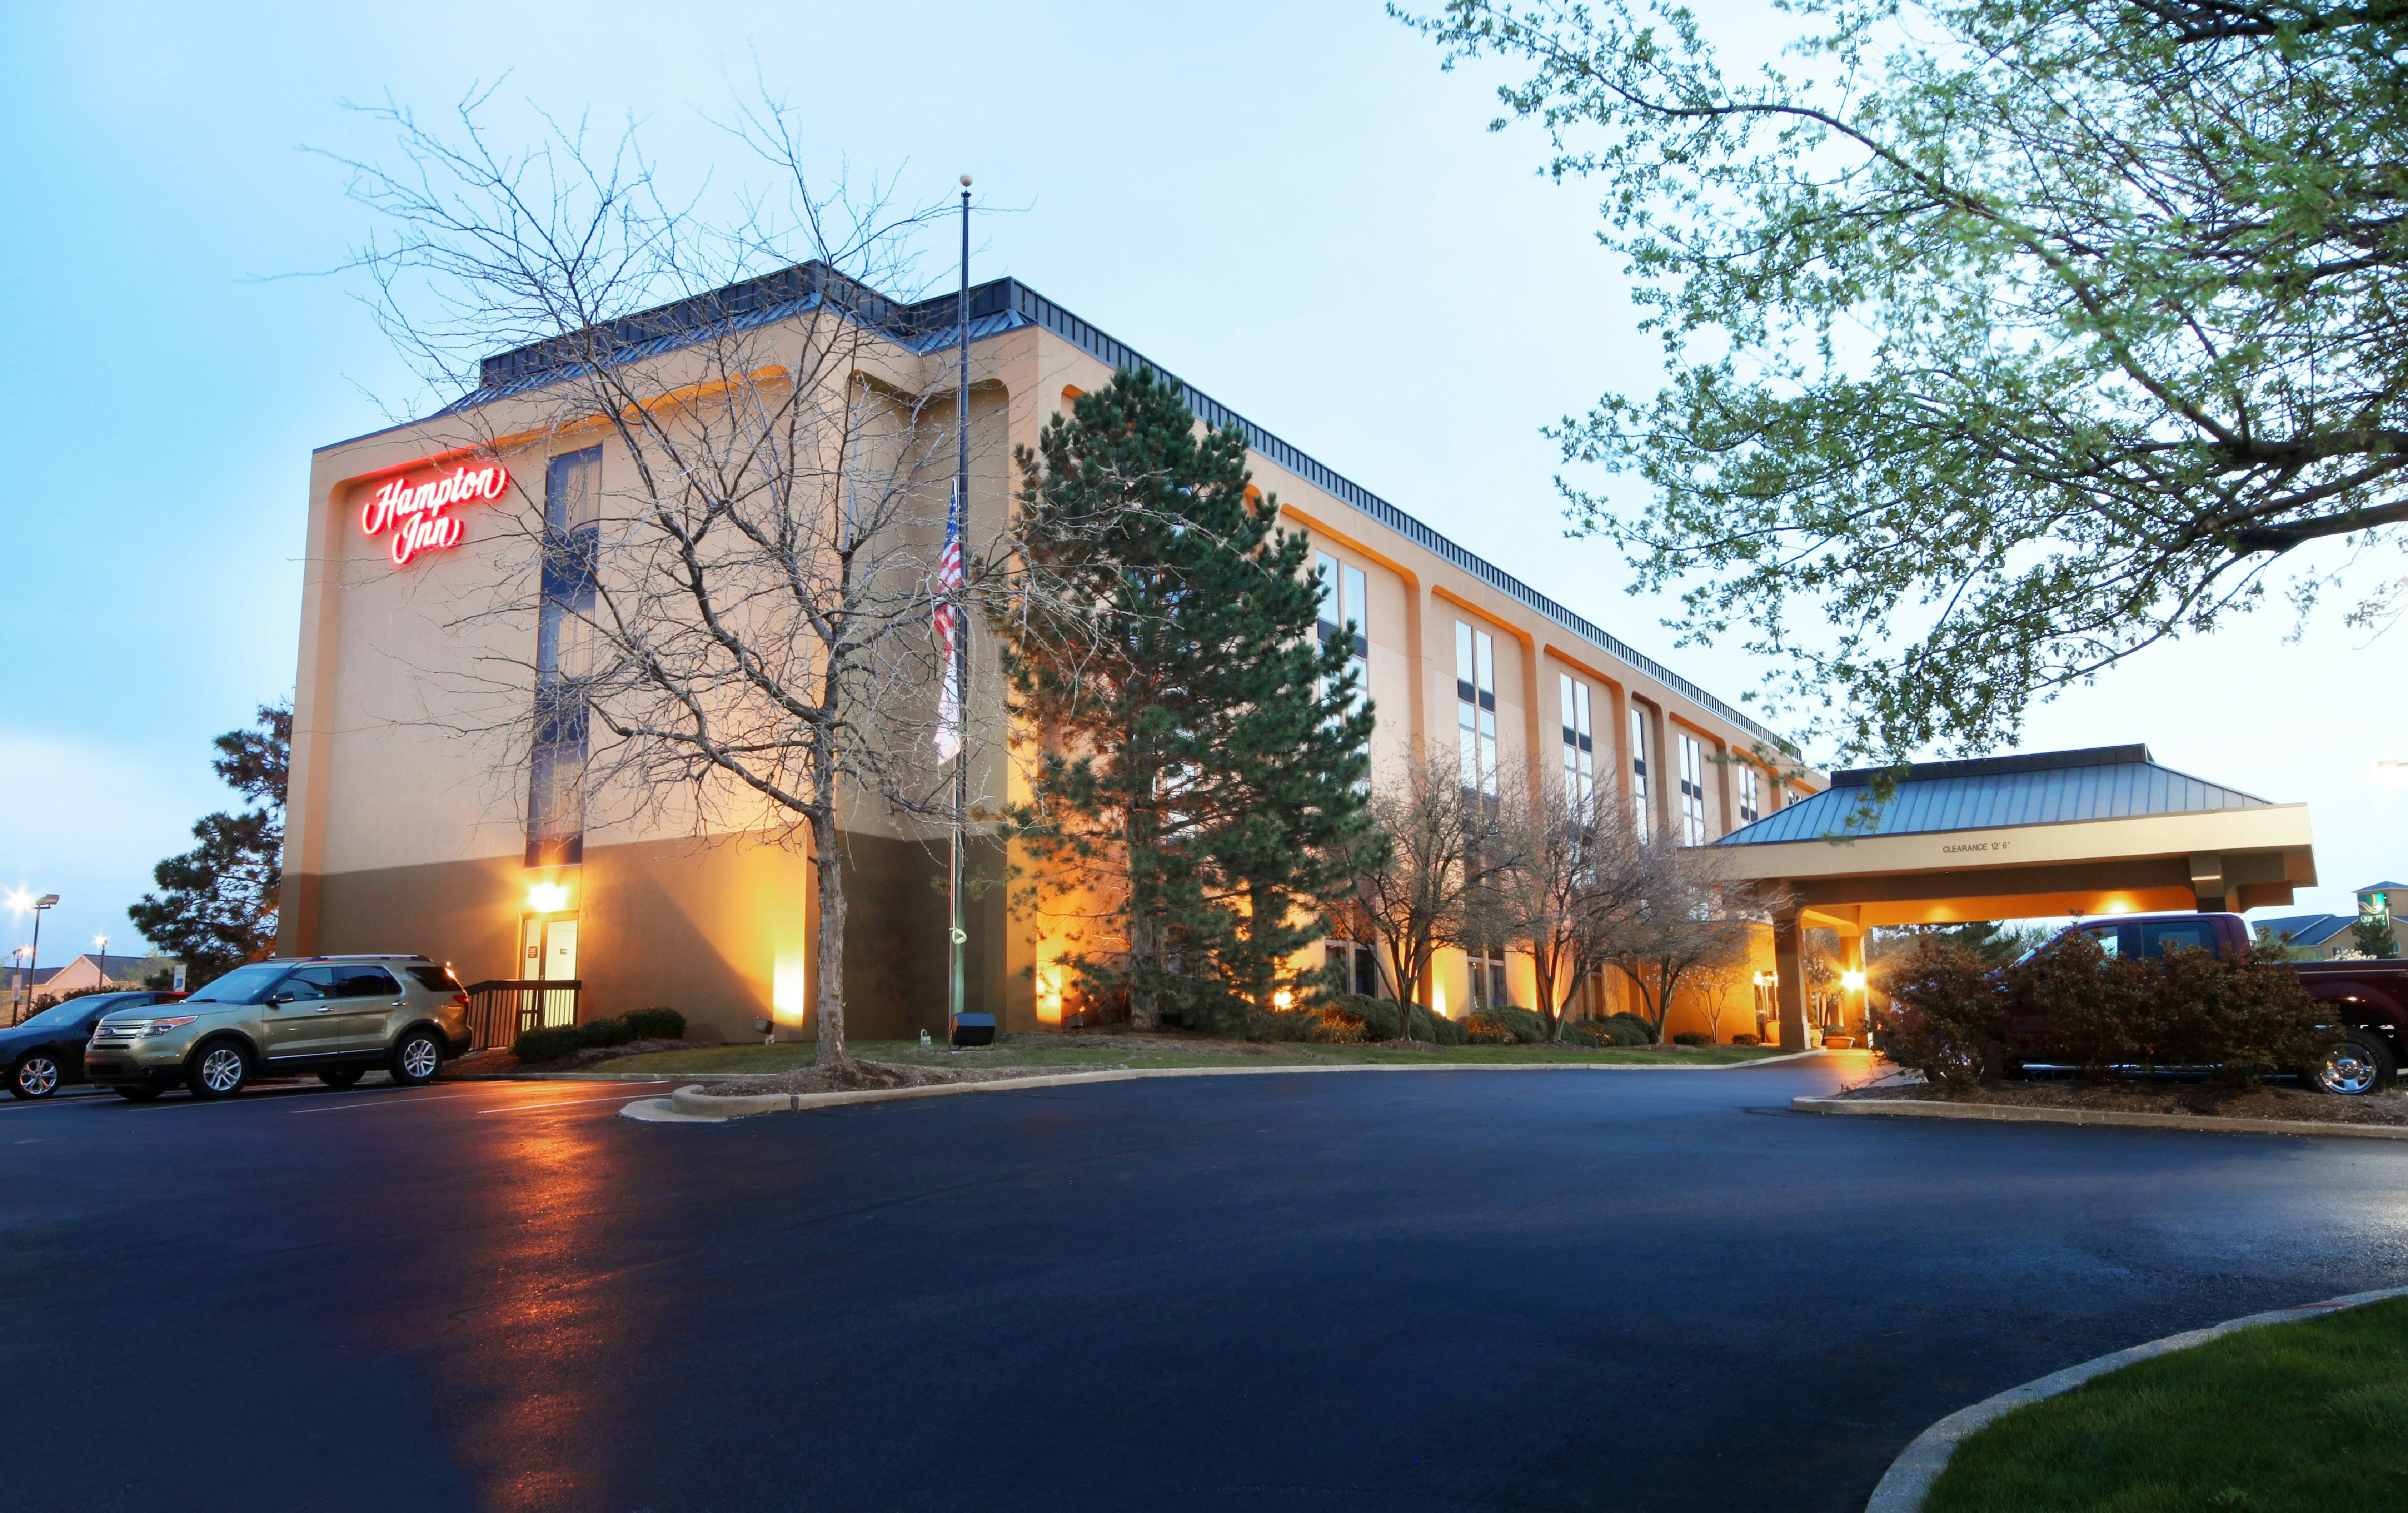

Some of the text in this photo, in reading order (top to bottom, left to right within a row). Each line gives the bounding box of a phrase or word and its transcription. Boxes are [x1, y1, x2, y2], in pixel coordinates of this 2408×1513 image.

[362, 467, 509, 535] Hampton
[393, 512, 463, 564] Inn
[1943, 843, 1988, 853] CLEARANCE
